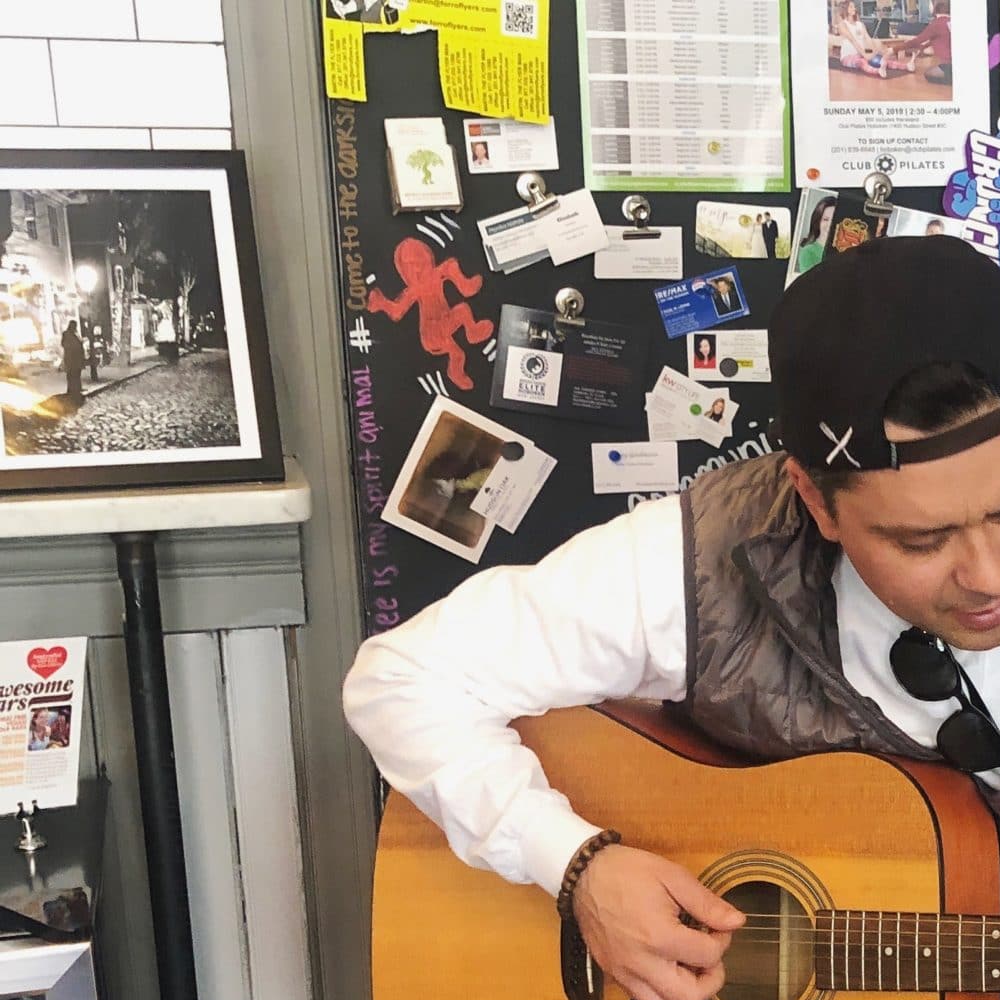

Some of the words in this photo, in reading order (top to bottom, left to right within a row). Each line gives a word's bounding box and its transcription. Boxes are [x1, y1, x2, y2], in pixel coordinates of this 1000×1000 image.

[823, 107, 856, 116] SUNDAY
[858, 107, 875, 116] MAY
[877, 107, 884, 117] 5,
[842, 161, 872, 170] CLUB
[899, 161, 945, 169] PILATES
[339, 183, 359, 222] the
[342, 227, 360, 250] to
[658, 284, 687, 299] RE/MAX
[373, 564, 398, 586] is
